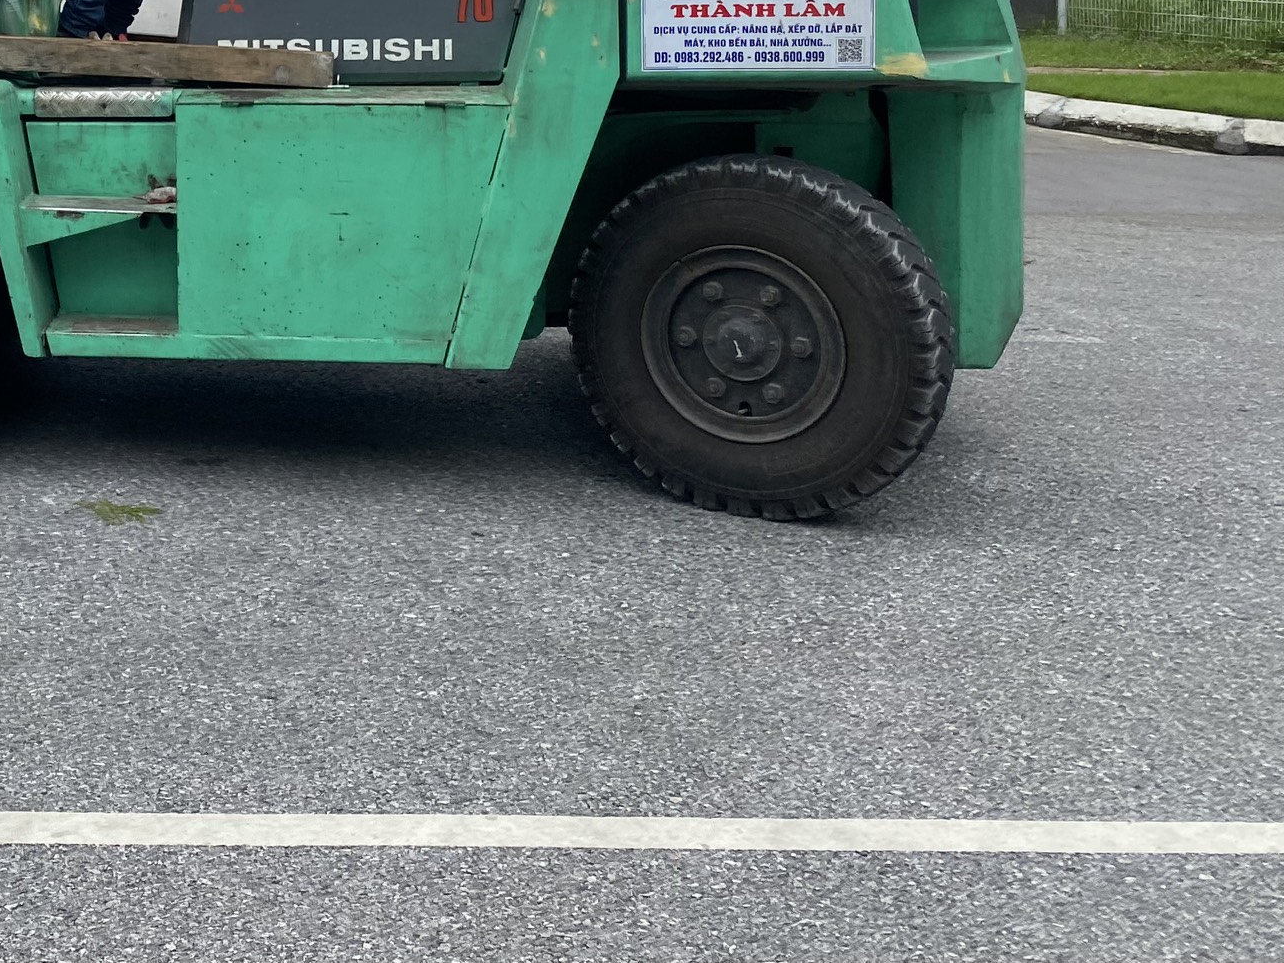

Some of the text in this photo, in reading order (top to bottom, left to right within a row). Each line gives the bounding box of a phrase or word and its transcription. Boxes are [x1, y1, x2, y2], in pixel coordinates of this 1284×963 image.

[670, 0, 776, 18] THÀNH
[654, 26, 675, 36] DỊCH
[677, 26, 689, 36] VỤ
[691, 26, 716, 34] CUNG
[718, 22, 740, 34] CẤP:
[742, 23, 768, 34] NÂNG
[770, 23, 785, 35] HẠ,
[788, 22, 806, 34] XẾP
[684, 37, 706, 48] MÁY,
[708, 38, 726, 47] KHO
[728, 36, 747, 47] BẾN
[770, 37, 789, 47] NHÀ
[674, 51, 744, 63] 0983.292.486
[754, 50, 825, 63] 0938.600.999
